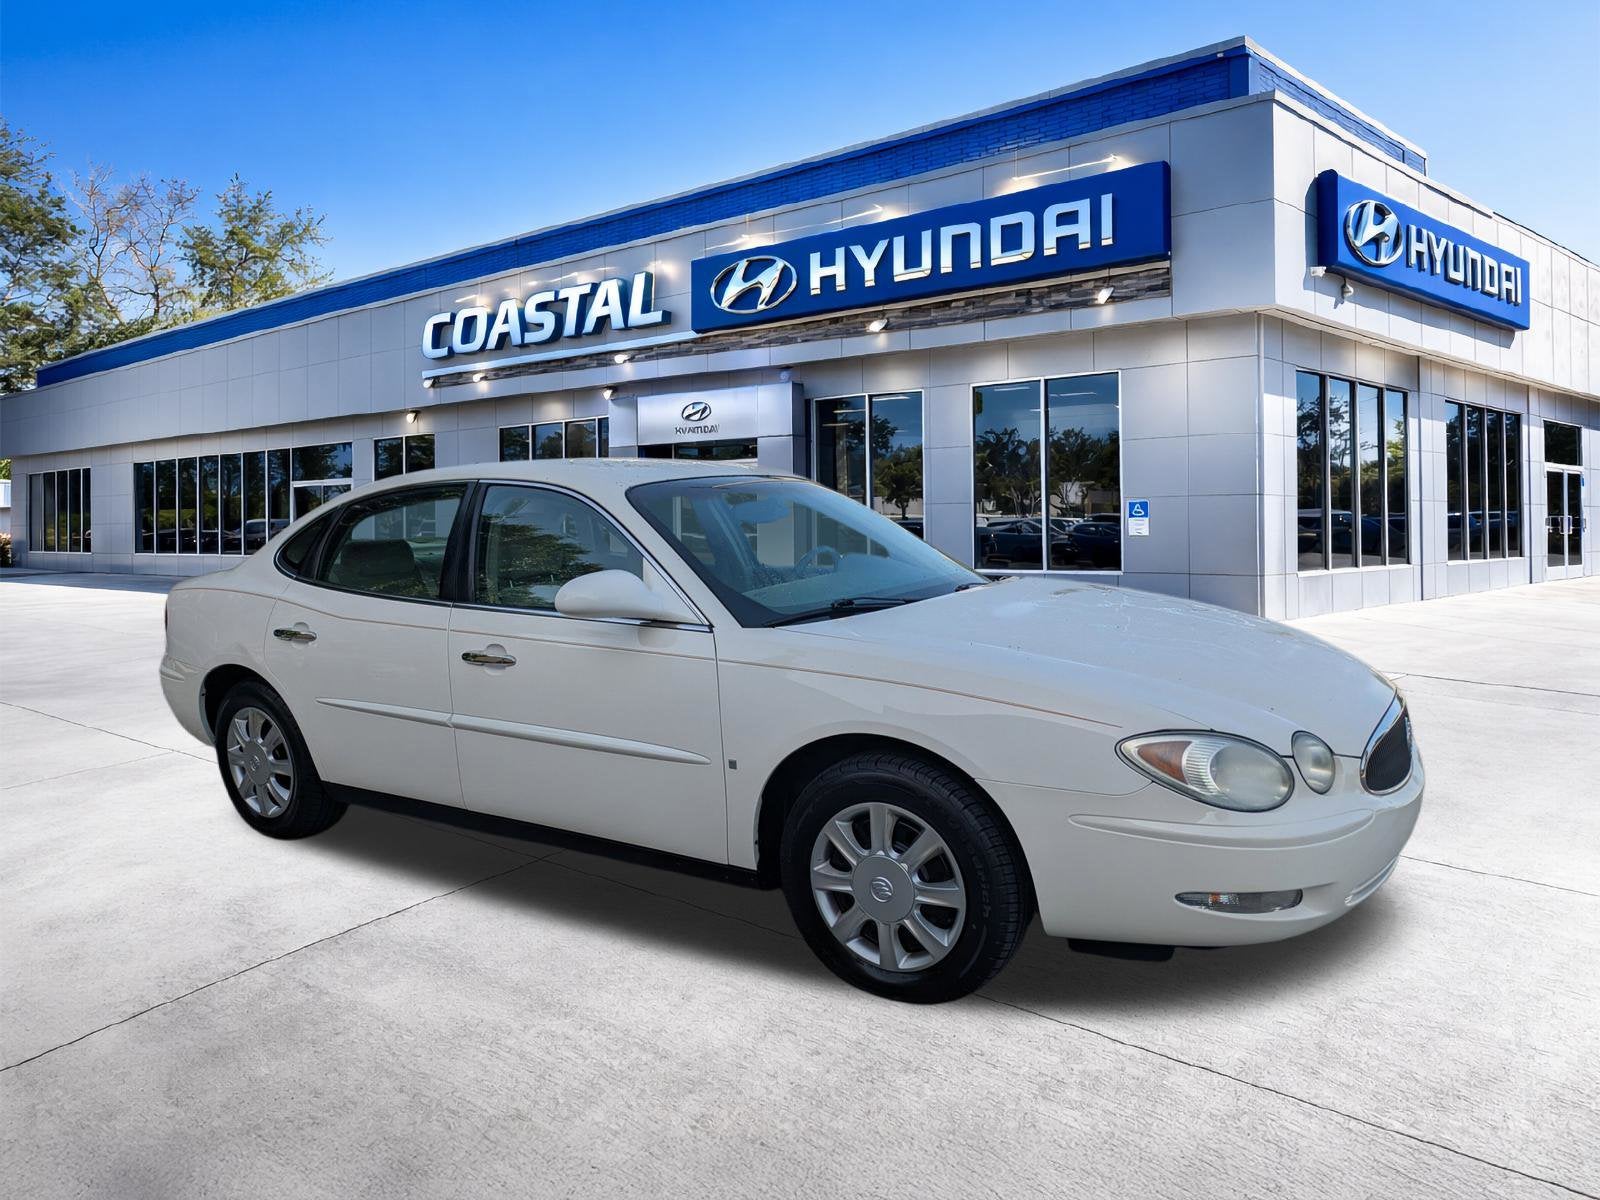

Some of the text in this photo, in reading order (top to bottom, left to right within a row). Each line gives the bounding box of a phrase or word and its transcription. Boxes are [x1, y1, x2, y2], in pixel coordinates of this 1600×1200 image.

[810, 193, 1114, 295] HYUNDAI
[1407, 224, 1522, 306] HYUNDAI
[422, 272, 669, 359] COASTAL
